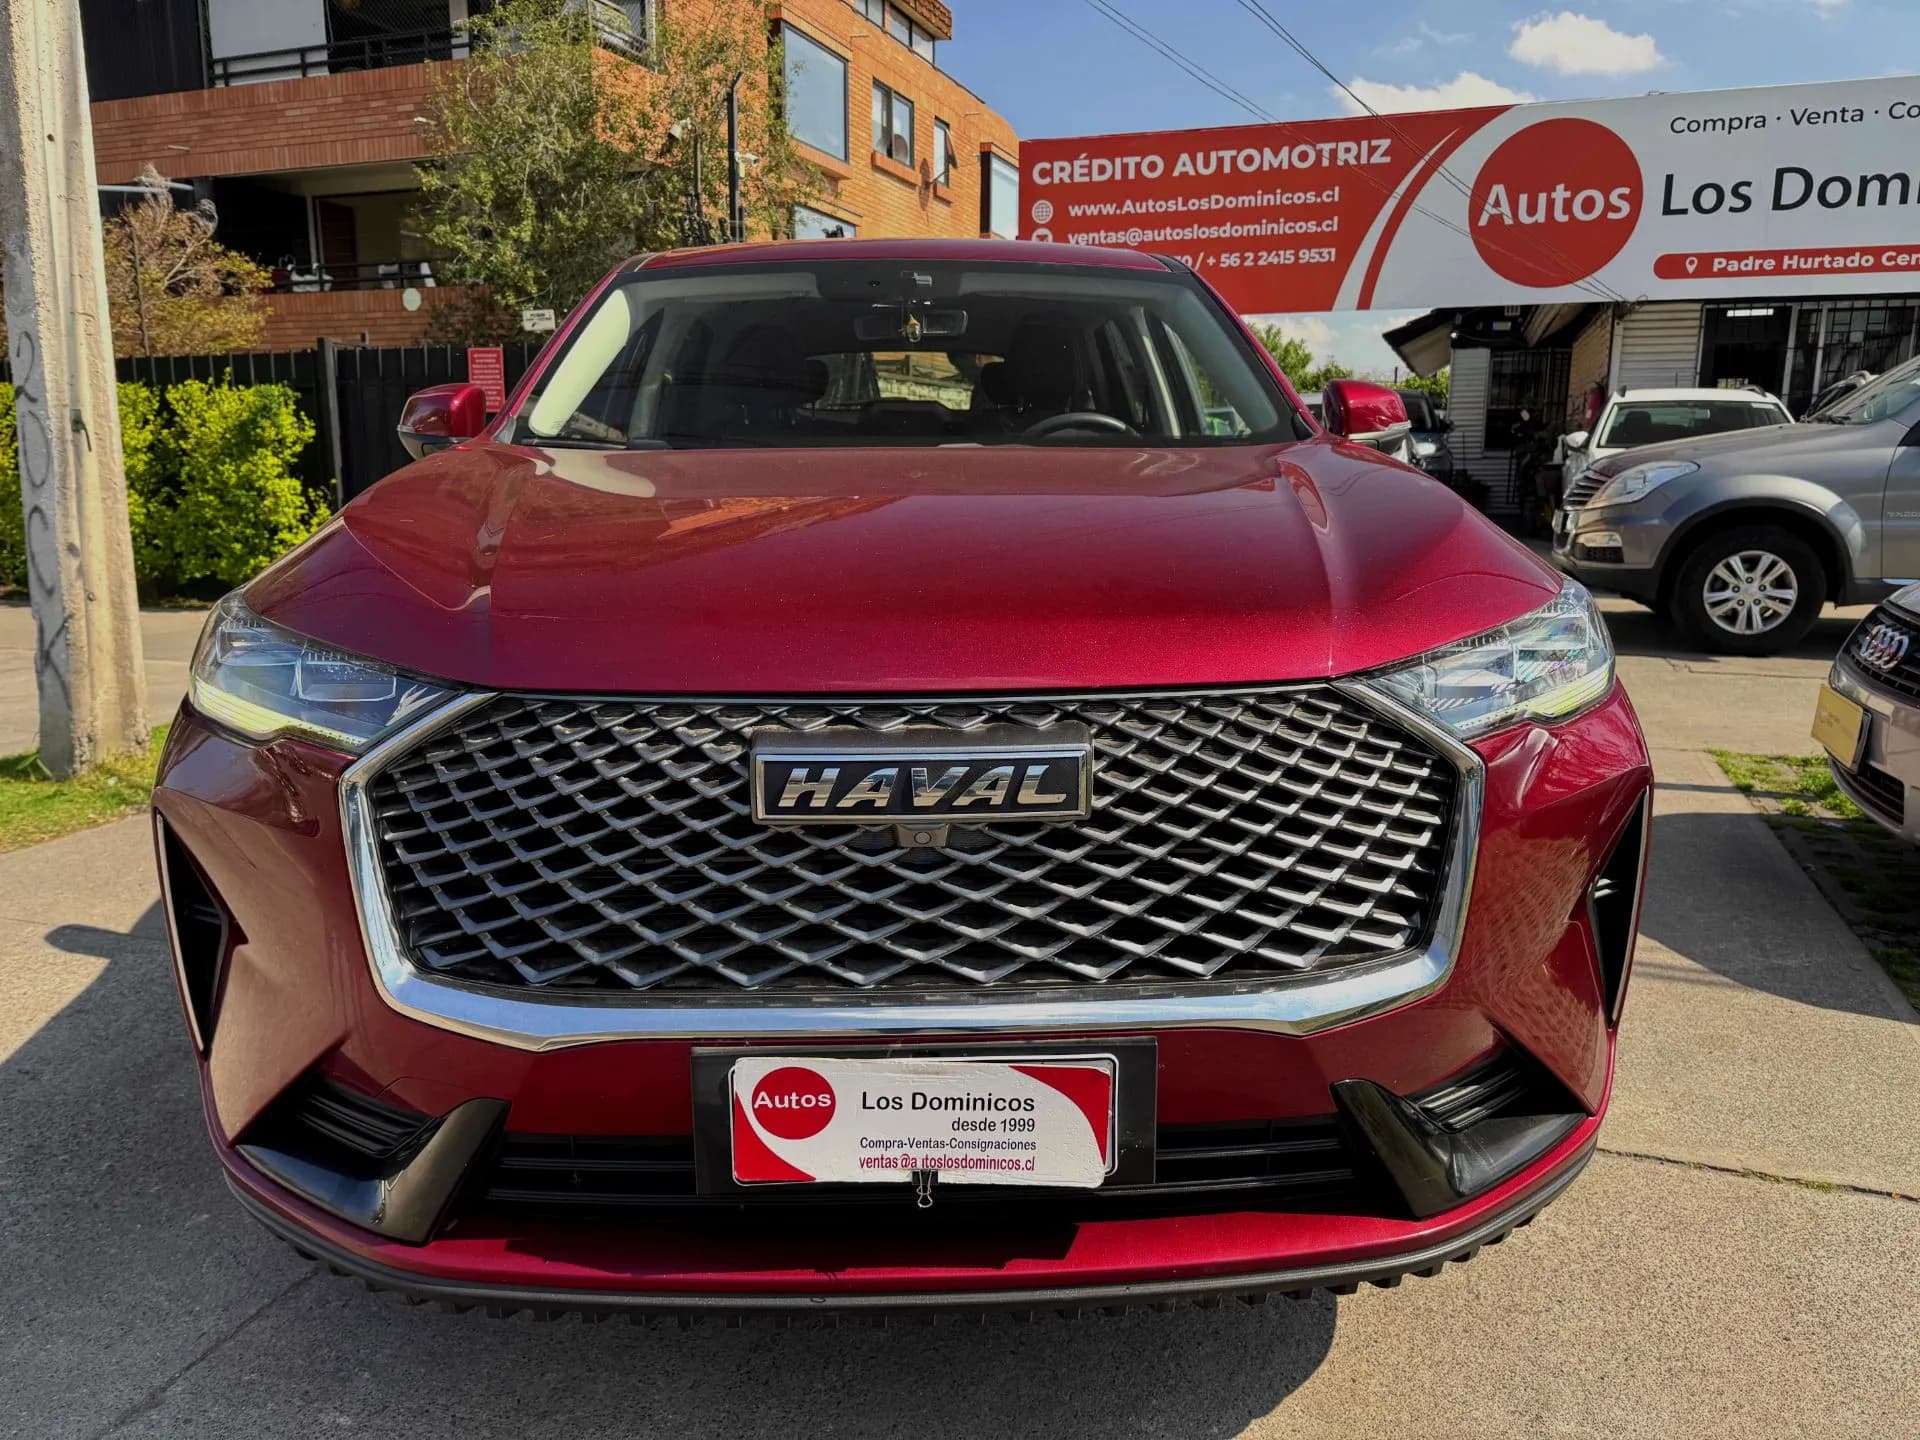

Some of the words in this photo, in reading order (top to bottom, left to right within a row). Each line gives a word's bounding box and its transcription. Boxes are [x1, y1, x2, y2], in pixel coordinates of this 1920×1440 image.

[1670, 114, 1767, 135] Compra
[1789, 105, 1864, 127] Venta
[1032, 153, 1165, 186] CRÉDITO
[1173, 138, 1392, 177] AUTOMOTRIZ
[1068, 186, 1340, 216] www.AutosLosDominicos.cl
[1477, 183, 1632, 228] Autos
[1661, 173, 1753, 217] Los
[1068, 216, 1339, 246] ventas@autoslosdominicos.cl
[1219, 252, 1241, 268] 56
[1244, 252, 1255, 266] 2
[1257, 250, 1295, 265] 2415
[1298, 248, 1337, 263] 9531
[1712, 254, 1776, 273] Padre
[1783, 251, 1875, 271] Hurtado
[778, 765, 1067, 808] HAVAL
[753, 1090, 832, 1110] Autos
[862, 1091, 904, 1111] Los
[912, 1091, 1036, 1112] Dominicos
[951, 1116, 997, 1132] desde
[1000, 1117, 1036, 1133] 1999
